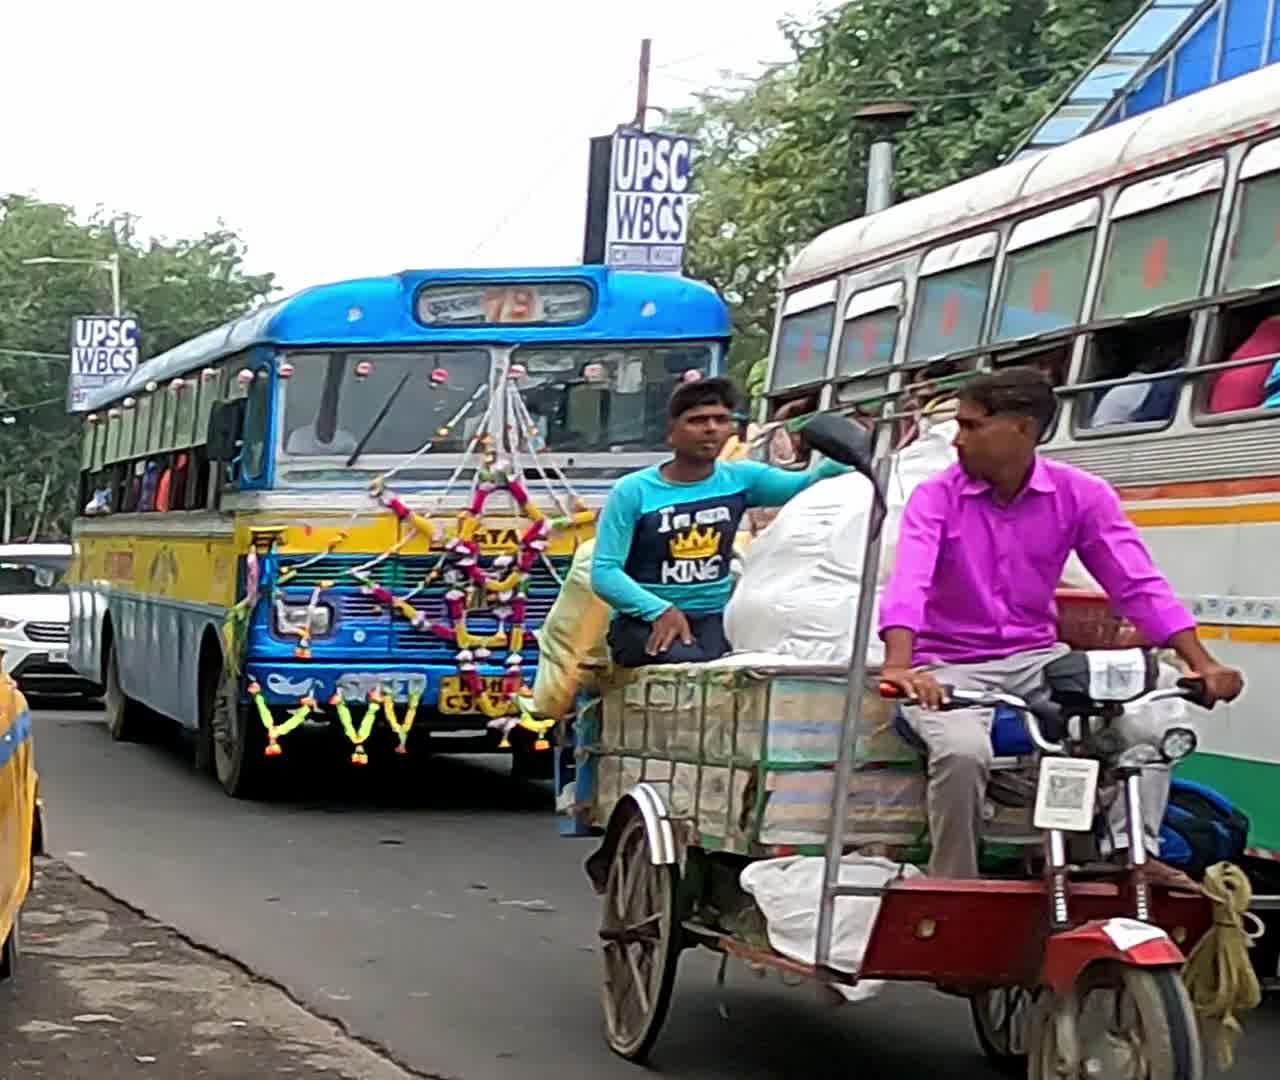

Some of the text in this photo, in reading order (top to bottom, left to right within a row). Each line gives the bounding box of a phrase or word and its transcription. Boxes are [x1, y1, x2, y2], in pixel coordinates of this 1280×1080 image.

[615, 138, 689, 192] UPSC
[615, 195, 683, 241] WBCS
[76, 319, 136, 347] UPSC
[78, 350, 132, 373] WBCS
[661, 555, 722, 584] KING
